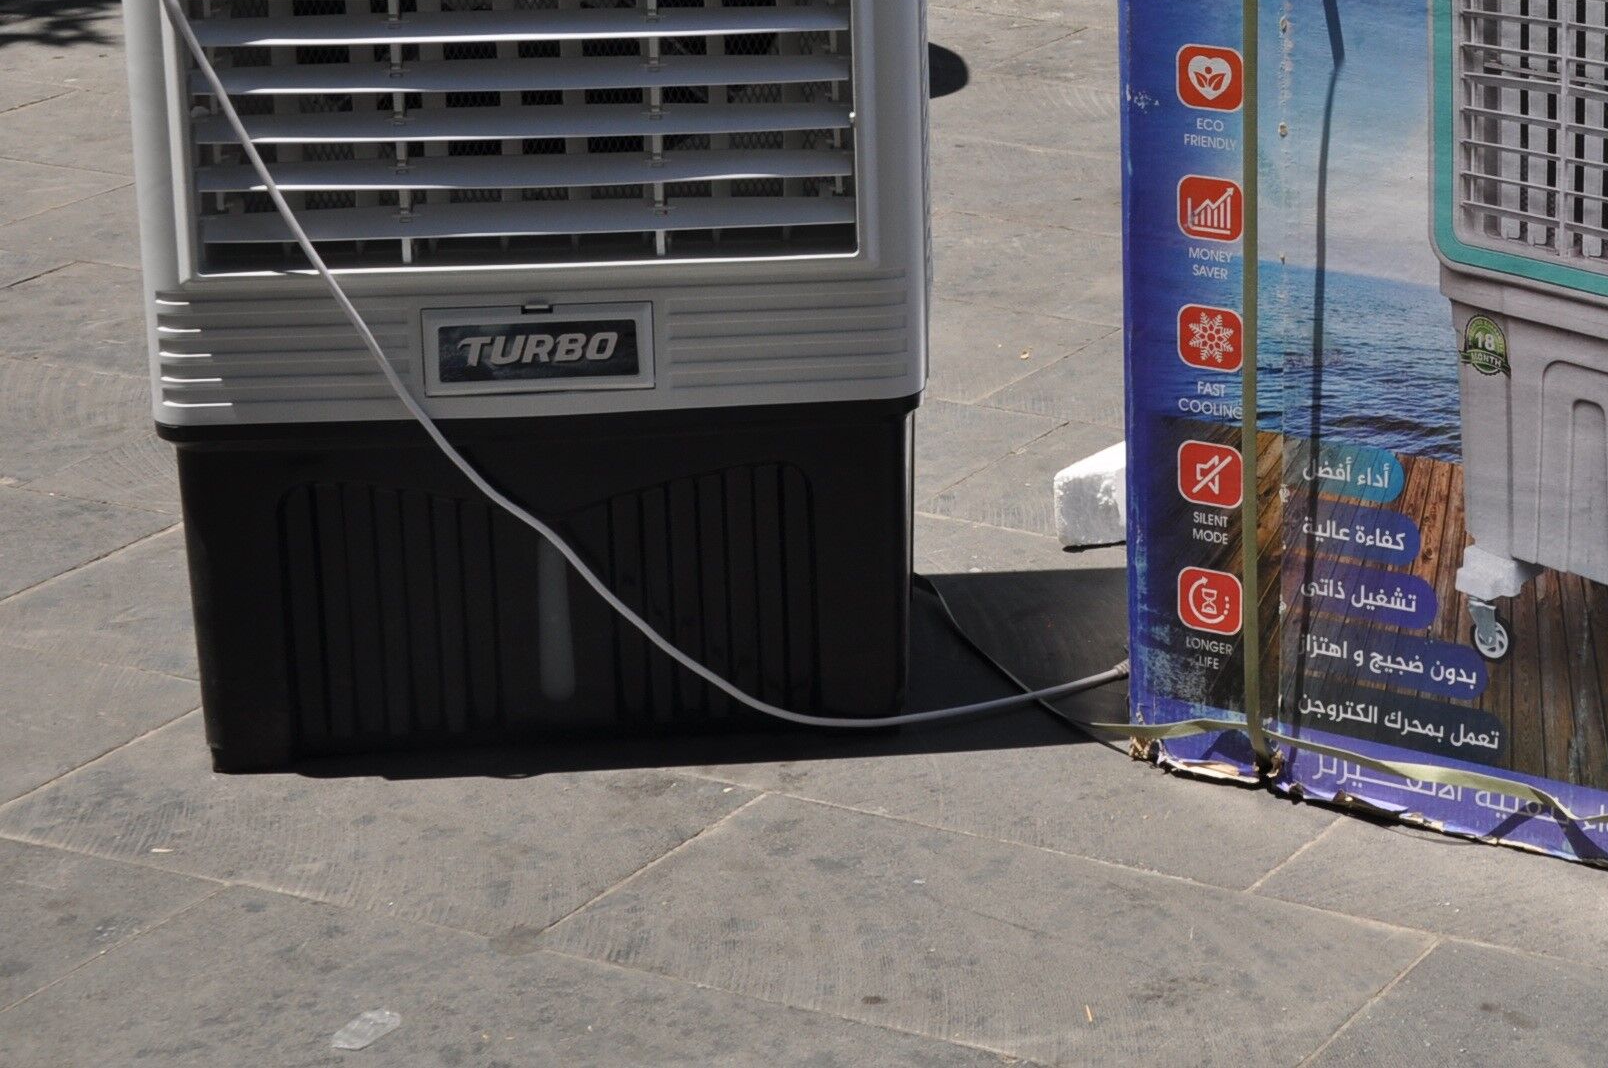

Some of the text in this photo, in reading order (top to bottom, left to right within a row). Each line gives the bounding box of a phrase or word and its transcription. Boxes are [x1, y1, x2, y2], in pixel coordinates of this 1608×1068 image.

[1196, 117, 1224, 132] ECO
[1183, 133, 1237, 151] FRIENDLY
[1188, 246, 1233, 263] MONEY
[1192, 263, 1228, 280] SAVER
[457, 330, 619, 367] TURBO
[1475, 331, 1496, 351] 18
[1197, 381, 1226, 398] FAST
[1178, 398, 1243, 420] COOLING
[1302, 456, 1391, 489] أداء أفضل
[1193, 511, 1229, 528] SILENT
[1192, 528, 1229, 545] MODE
[1355, 524, 1407, 552] كفاءة
[1351, 584, 1418, 613] تشغيل
[1185, 636, 1233, 656] LONGER
[1196, 655, 1220, 670] LIFE
[1352, 650, 1364, 667] و
[1368, 650, 1424, 675] ضجيج
[1430, 660, 1478, 689] بدون
[1384, 710, 1445, 743] بمحرك
[1450, 723, 1500, 750] تعمل
